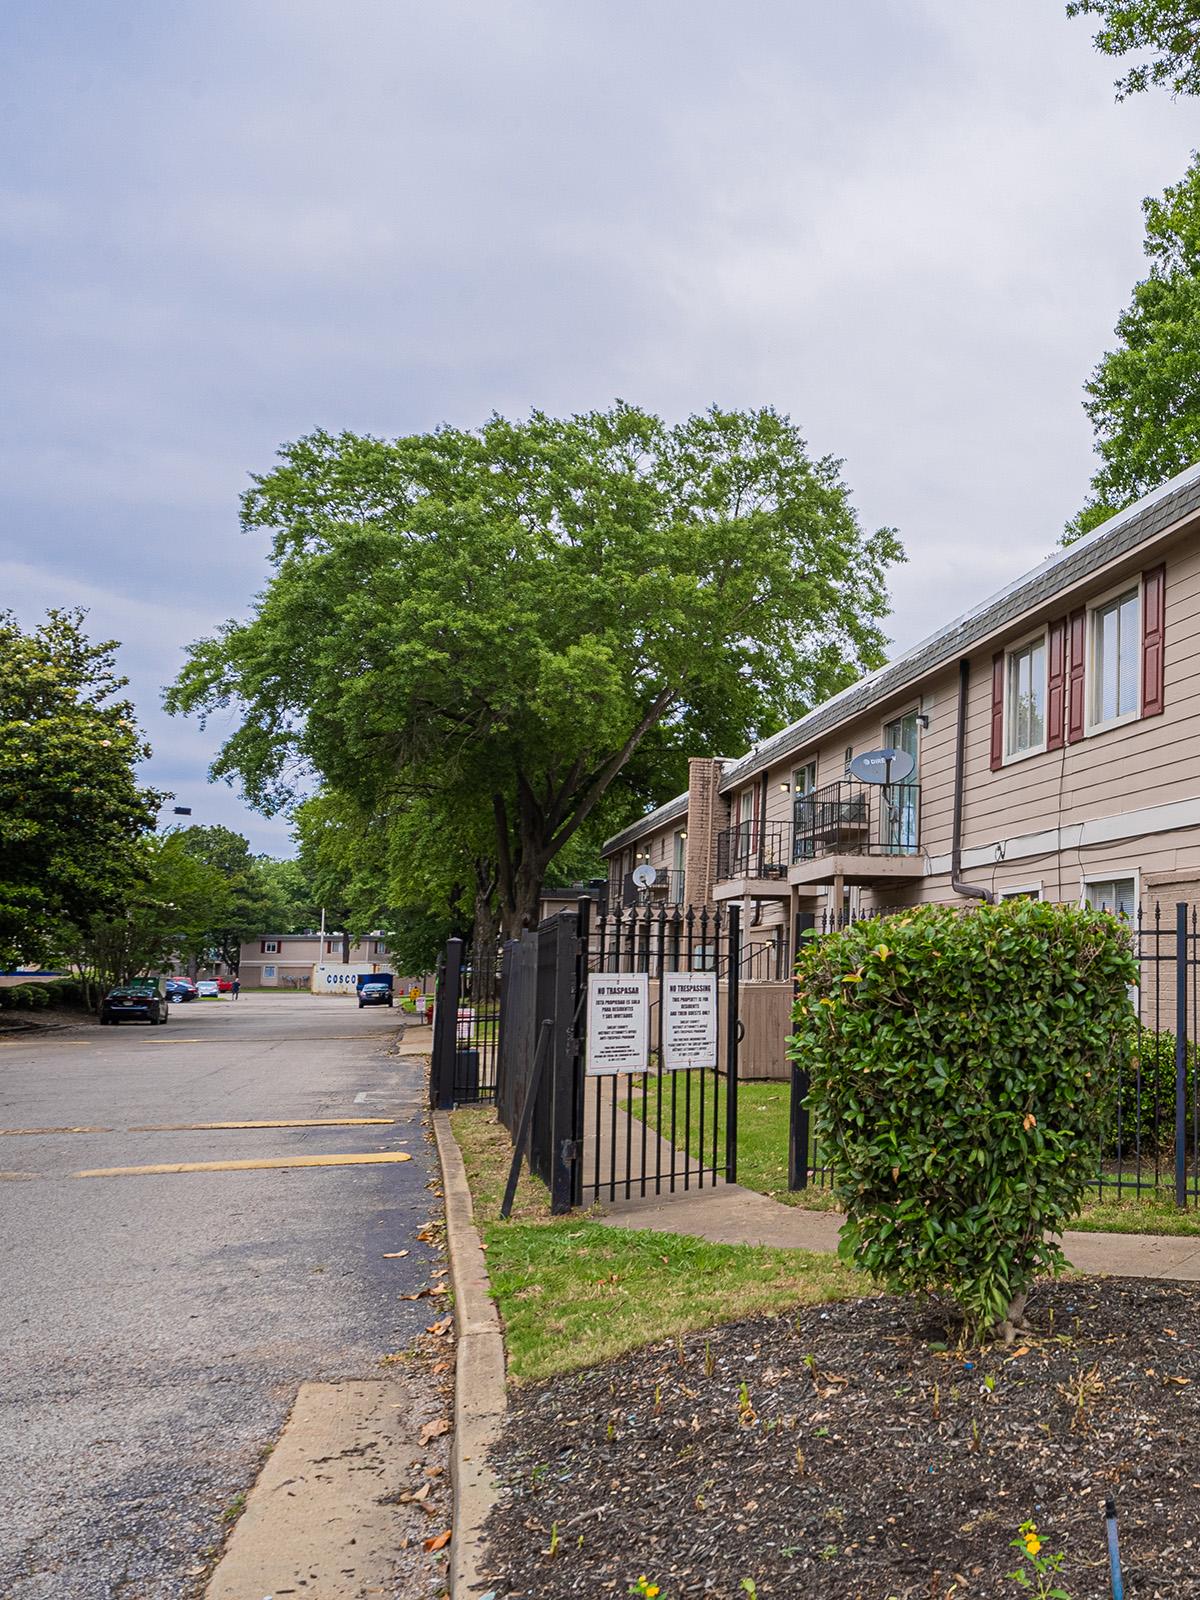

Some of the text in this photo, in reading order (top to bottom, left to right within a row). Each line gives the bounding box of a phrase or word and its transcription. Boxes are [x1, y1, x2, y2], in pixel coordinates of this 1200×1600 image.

[327, 974, 356, 984] COSCO
[606, 986, 639, 994] TRASPASAR
[678, 984, 711, 992] TRESPASSING
